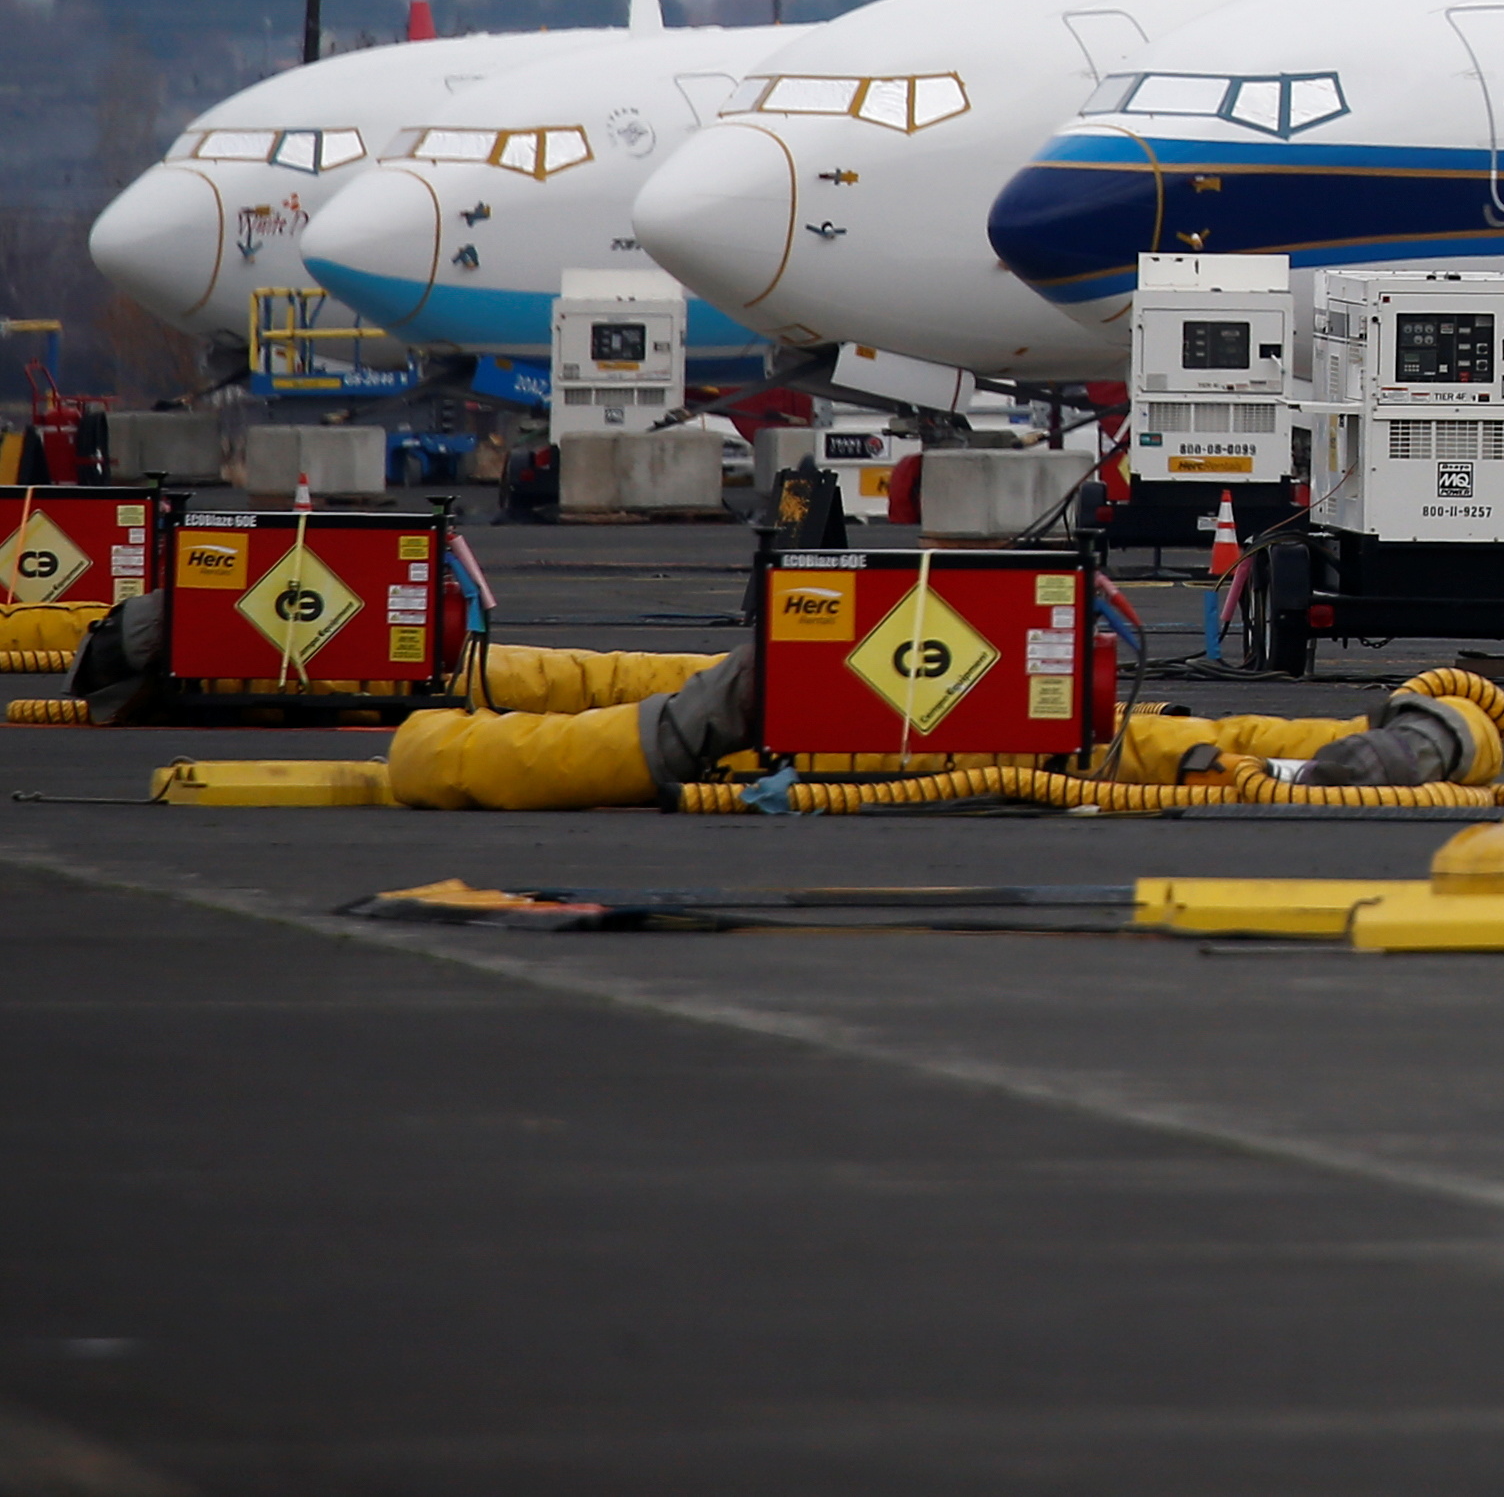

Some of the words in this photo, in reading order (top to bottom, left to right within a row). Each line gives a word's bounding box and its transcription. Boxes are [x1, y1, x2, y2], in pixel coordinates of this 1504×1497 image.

[1434, 392, 1454, 401] TIER
[1440, 473, 1471, 487] MQ
[188, 551, 236, 568] Herc
[784, 596, 841, 615] Herc
